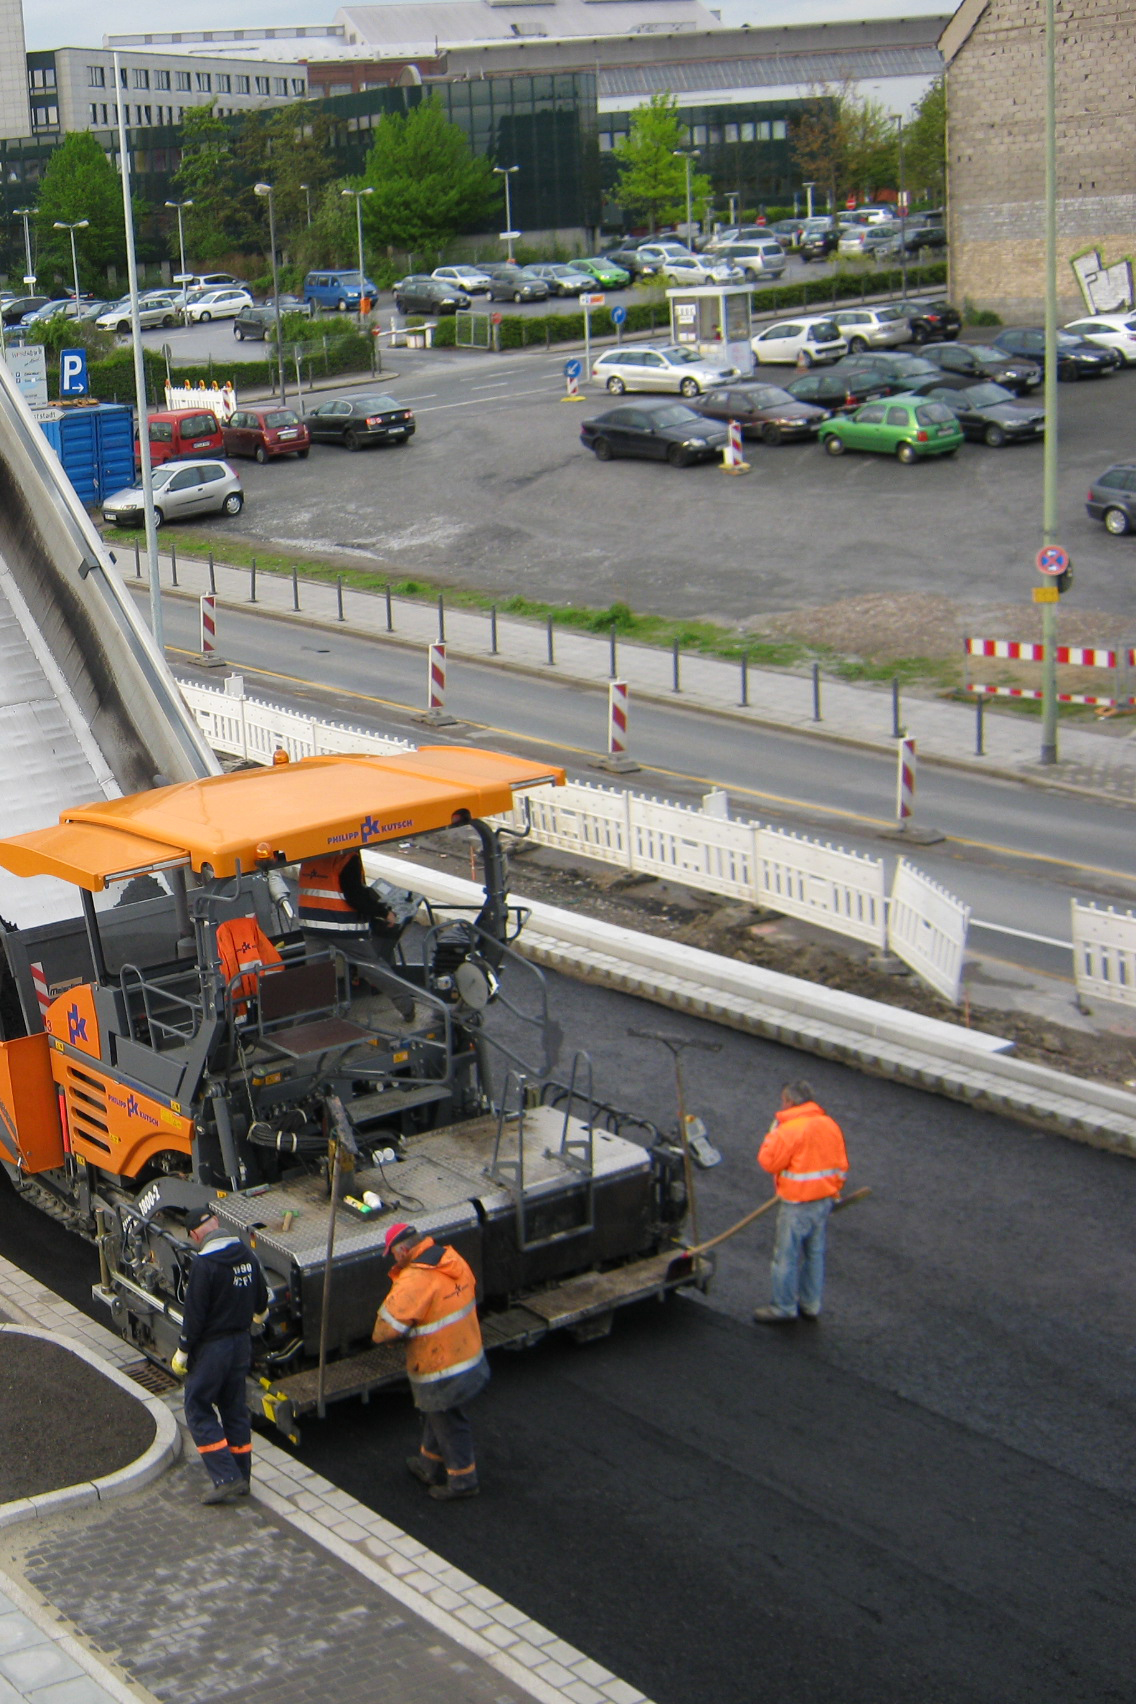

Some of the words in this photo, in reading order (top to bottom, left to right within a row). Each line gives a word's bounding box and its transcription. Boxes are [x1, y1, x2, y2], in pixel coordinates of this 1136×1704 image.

[63, 355, 83, 390] P
[327, 832, 360, 845] PHILIPP
[381, 819, 414, 833] KUTSCH
[108, 1095, 126, 1108] PHILIPP
[139, 1111, 159, 1127] KUTSCH
